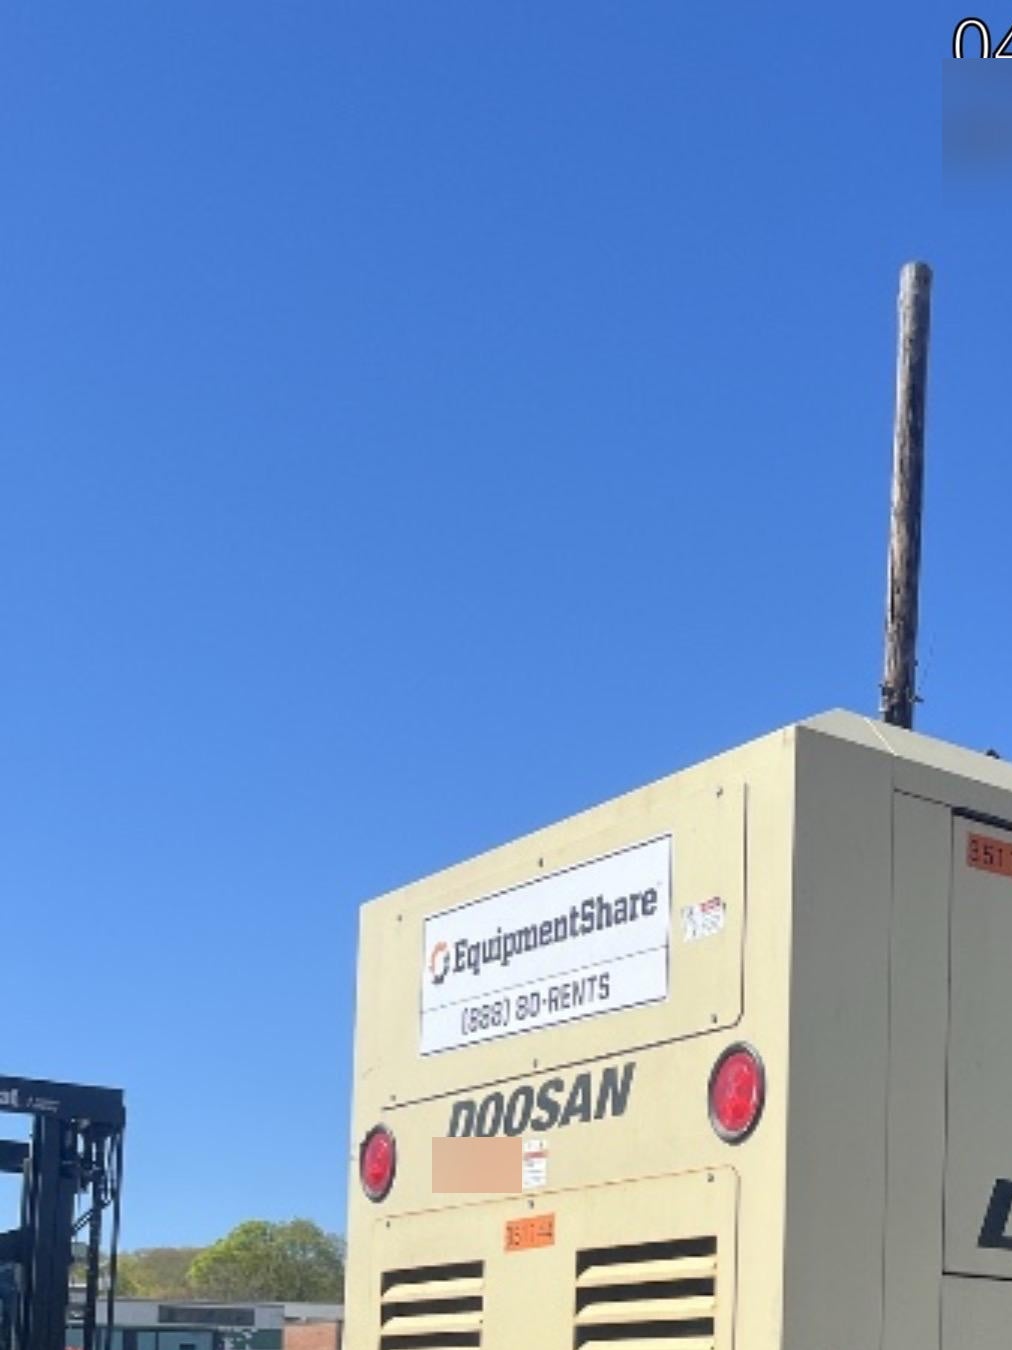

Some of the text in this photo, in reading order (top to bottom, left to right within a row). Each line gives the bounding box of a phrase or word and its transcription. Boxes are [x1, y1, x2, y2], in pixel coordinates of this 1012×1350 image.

[452, 886, 659, 976] EquipmentShare
[461, 996, 511, 1036] (888)
[447, 1061, 637, 1138] DOOSAN
